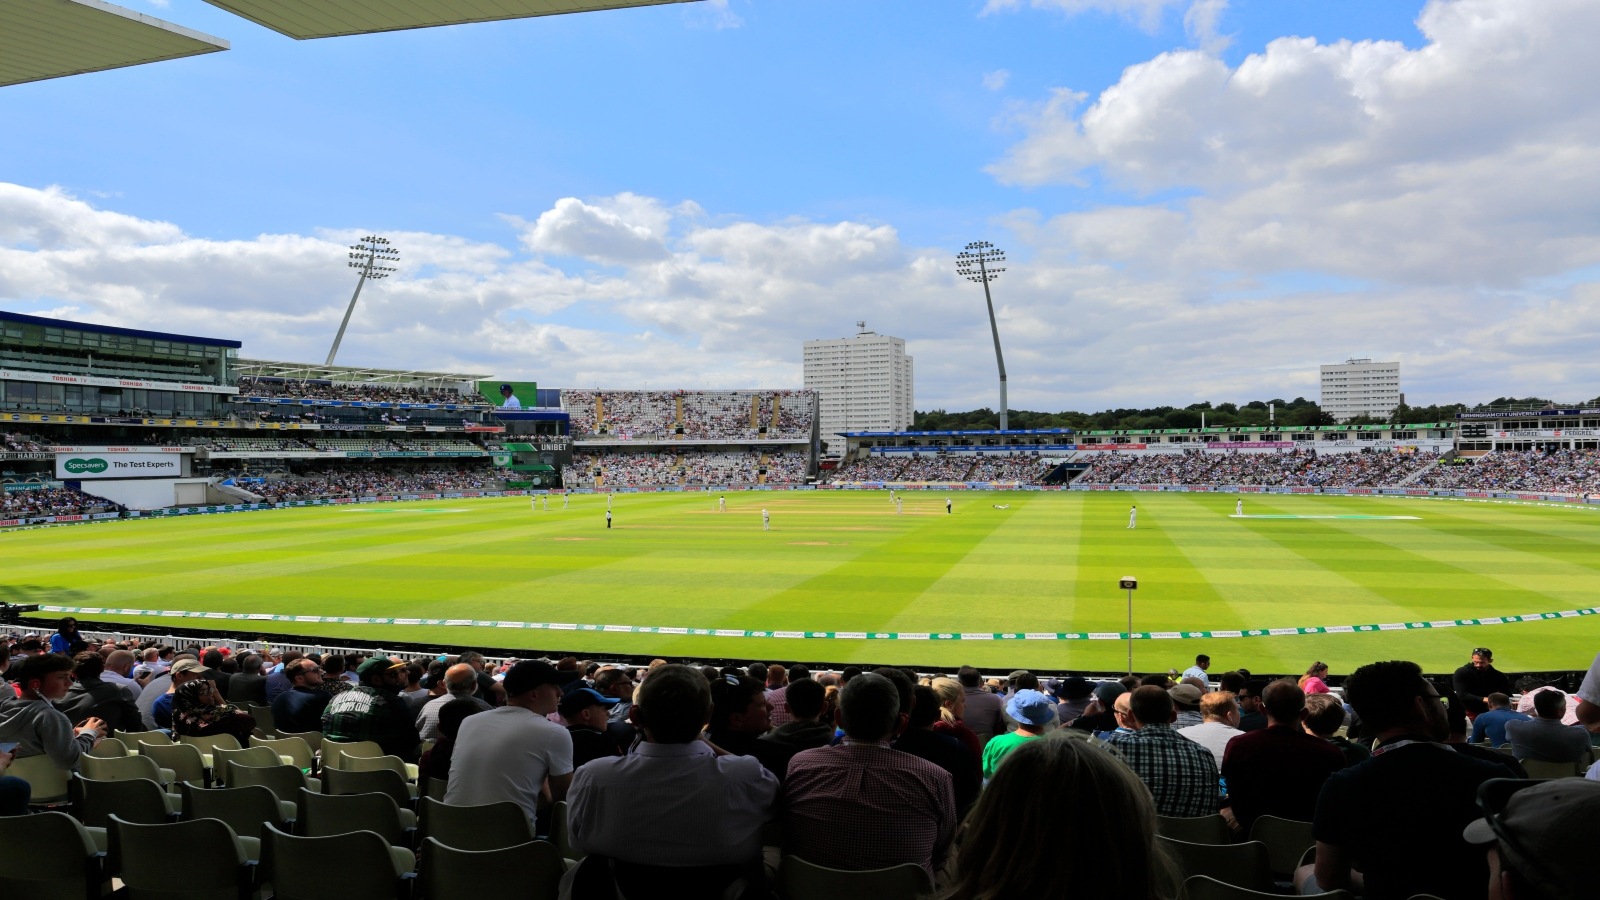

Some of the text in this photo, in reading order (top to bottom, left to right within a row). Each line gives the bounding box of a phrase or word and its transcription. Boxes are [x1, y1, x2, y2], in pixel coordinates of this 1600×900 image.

[52, 375, 77, 383] TOSHIBA
[541, 443, 567, 451] UNIBET
[68, 462, 105, 470] Specsavers
[147, 461, 174, 469] Experts
[54, 514, 82, 522] TOSHIBA
[355, 702, 370, 713] CLUB
